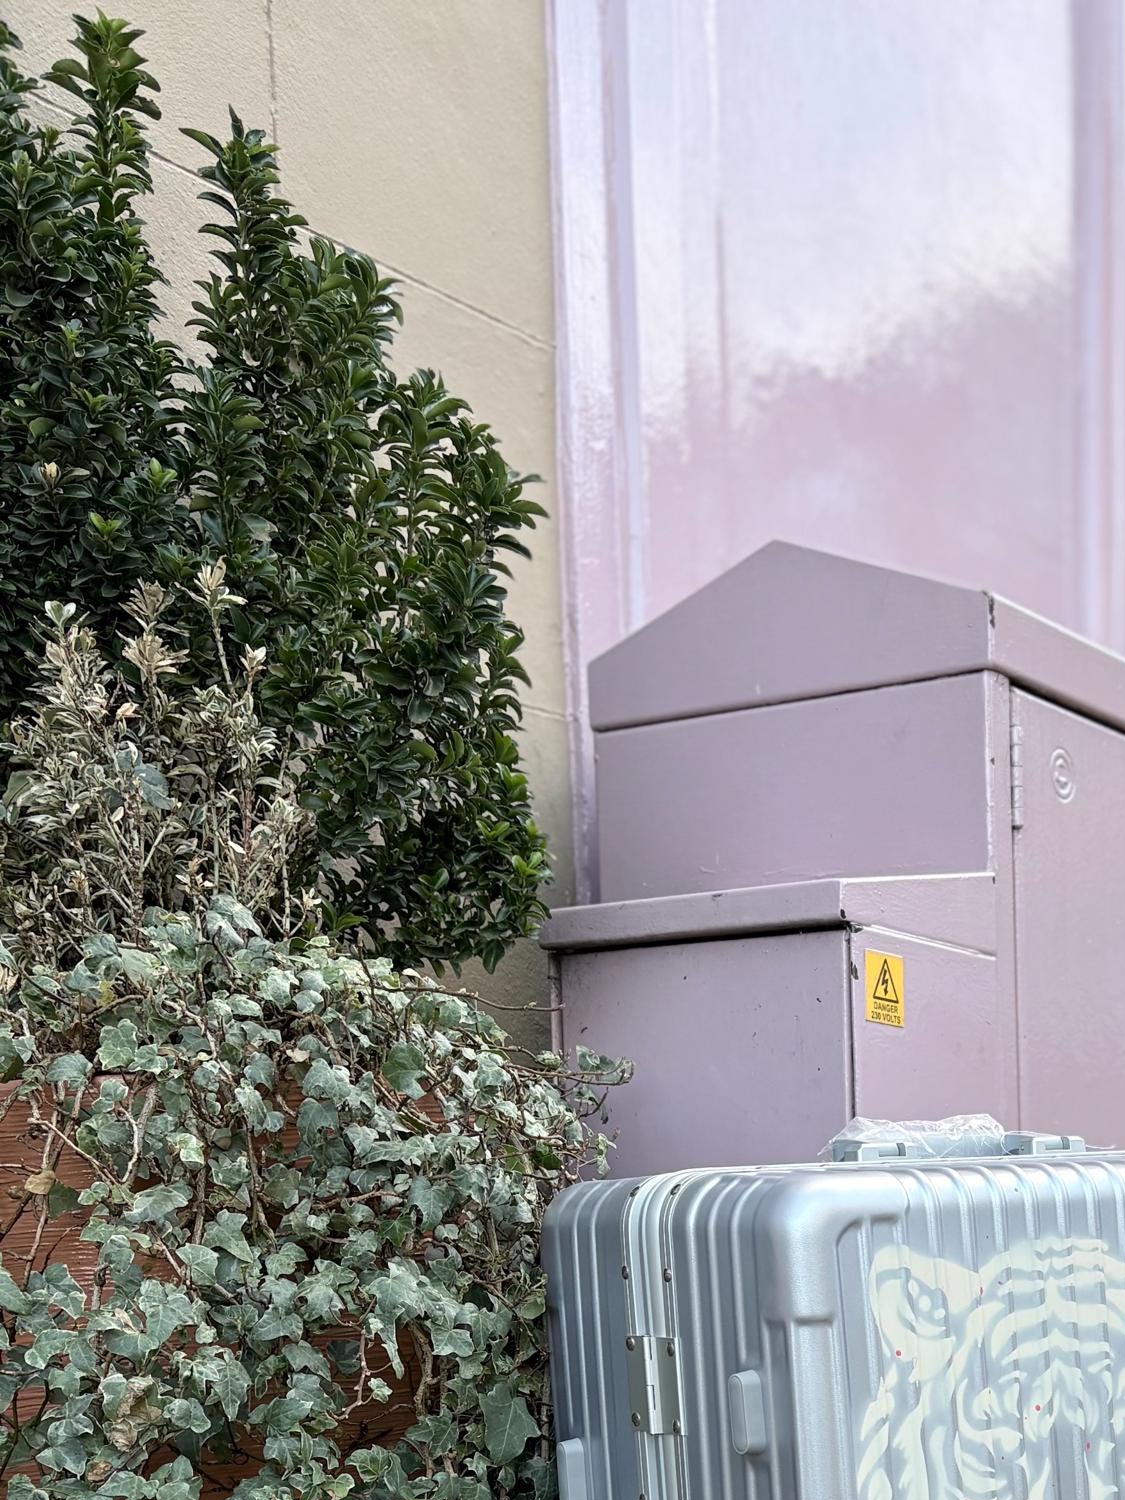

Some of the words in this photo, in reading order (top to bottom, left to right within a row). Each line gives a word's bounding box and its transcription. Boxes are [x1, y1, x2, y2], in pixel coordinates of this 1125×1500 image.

[874, 1002, 899, 1014] DANGER
[871, 1011, 881, 1020] 230
[882, 1013, 901, 1024] VOLTS
